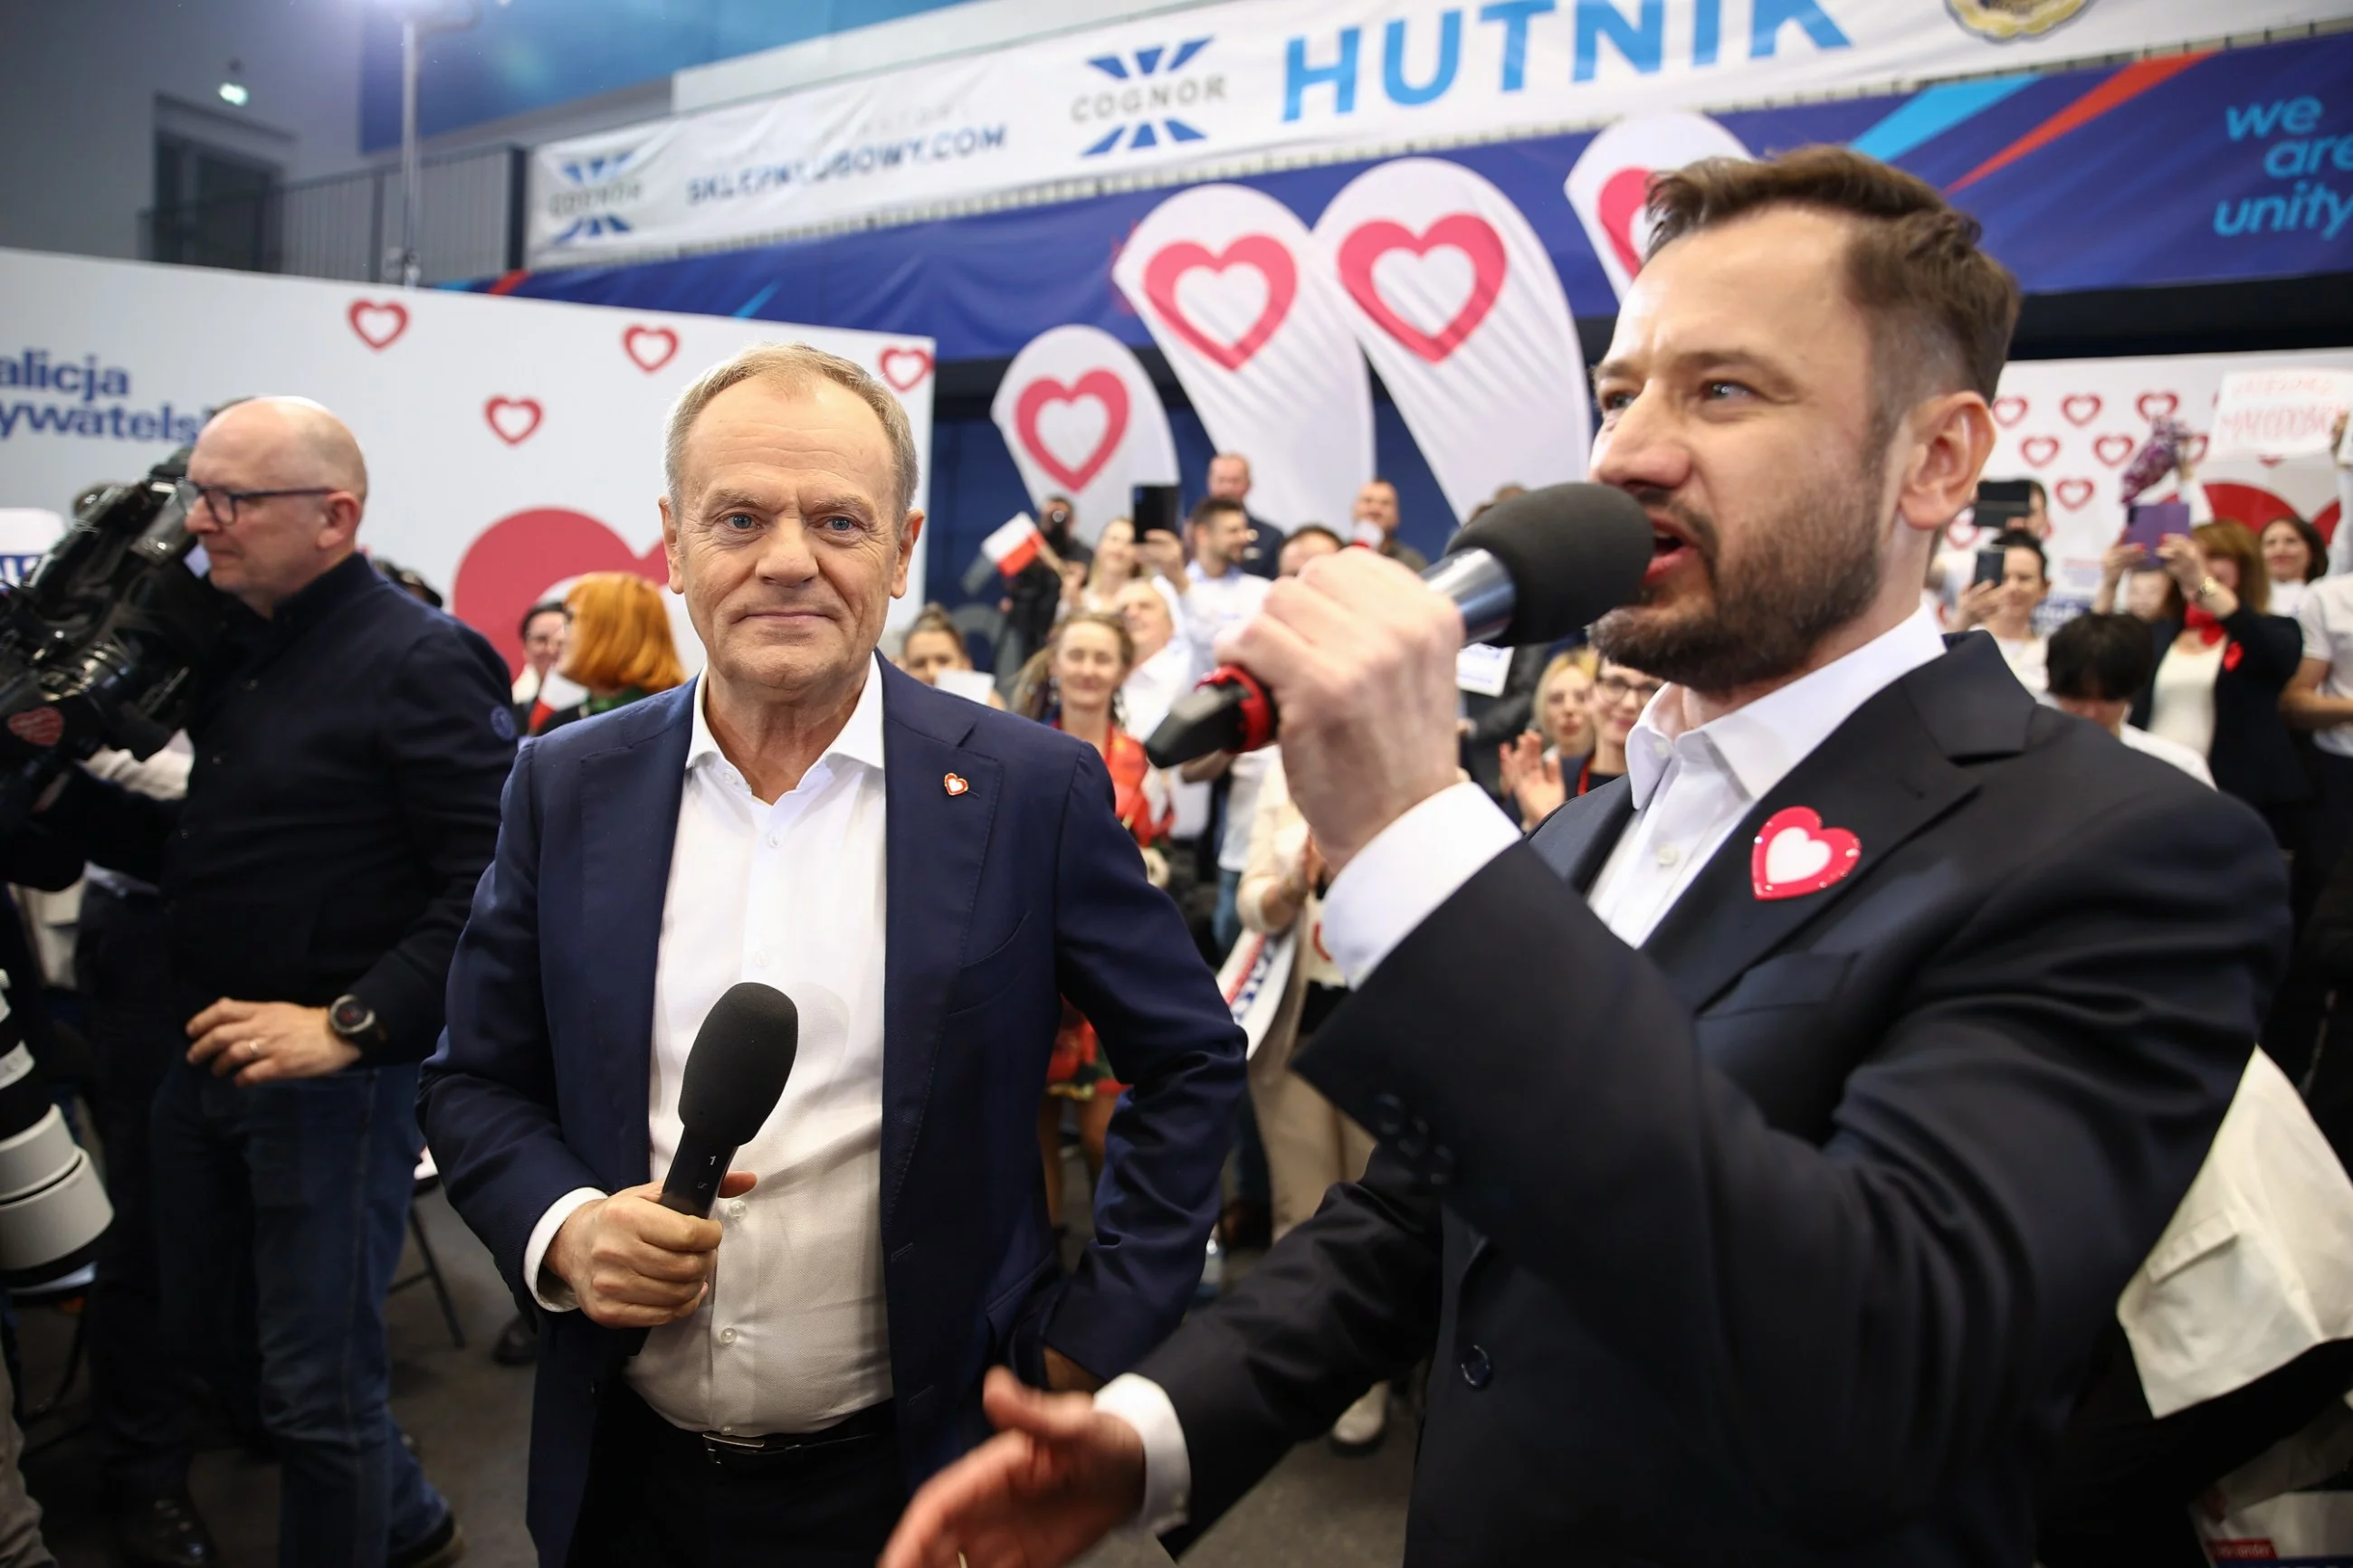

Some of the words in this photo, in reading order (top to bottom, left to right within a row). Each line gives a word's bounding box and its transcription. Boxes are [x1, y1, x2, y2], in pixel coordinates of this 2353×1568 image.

[1281, 0, 1853, 123] HUTNIK
[1070, 74, 1229, 124] COGNOR
[2224, 95, 2325, 142] we
[2263, 133, 2353, 179] are
[2213, 179, 2353, 241] unity
